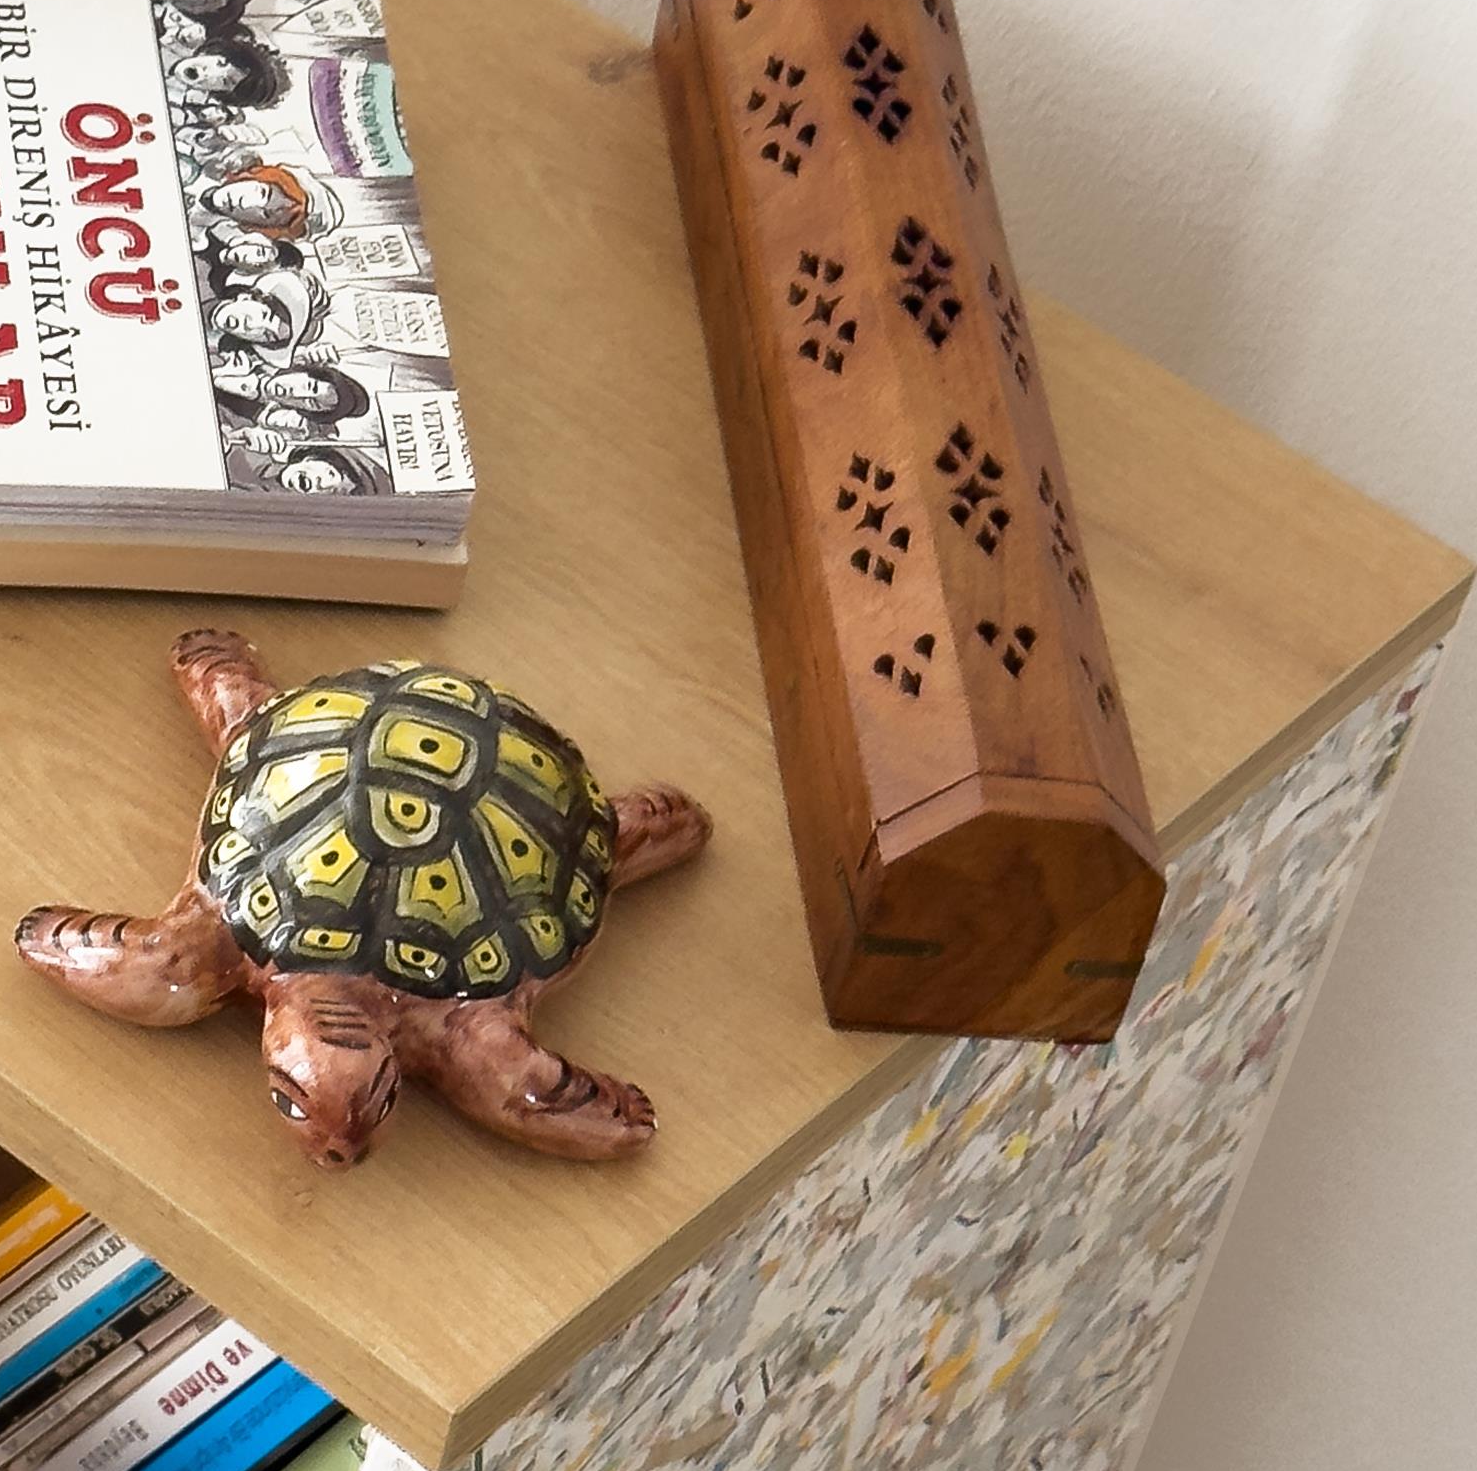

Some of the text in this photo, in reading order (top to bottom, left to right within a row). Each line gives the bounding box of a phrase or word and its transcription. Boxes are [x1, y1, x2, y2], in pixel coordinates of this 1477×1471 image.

[4, 77, 56, 231] DİRENİŞ
[60, 102, 183, 325] ÖNCÜ
[26, 244, 91, 433] HİKÂYESİ
[156, 1338, 253, 1416] ve Dimne
